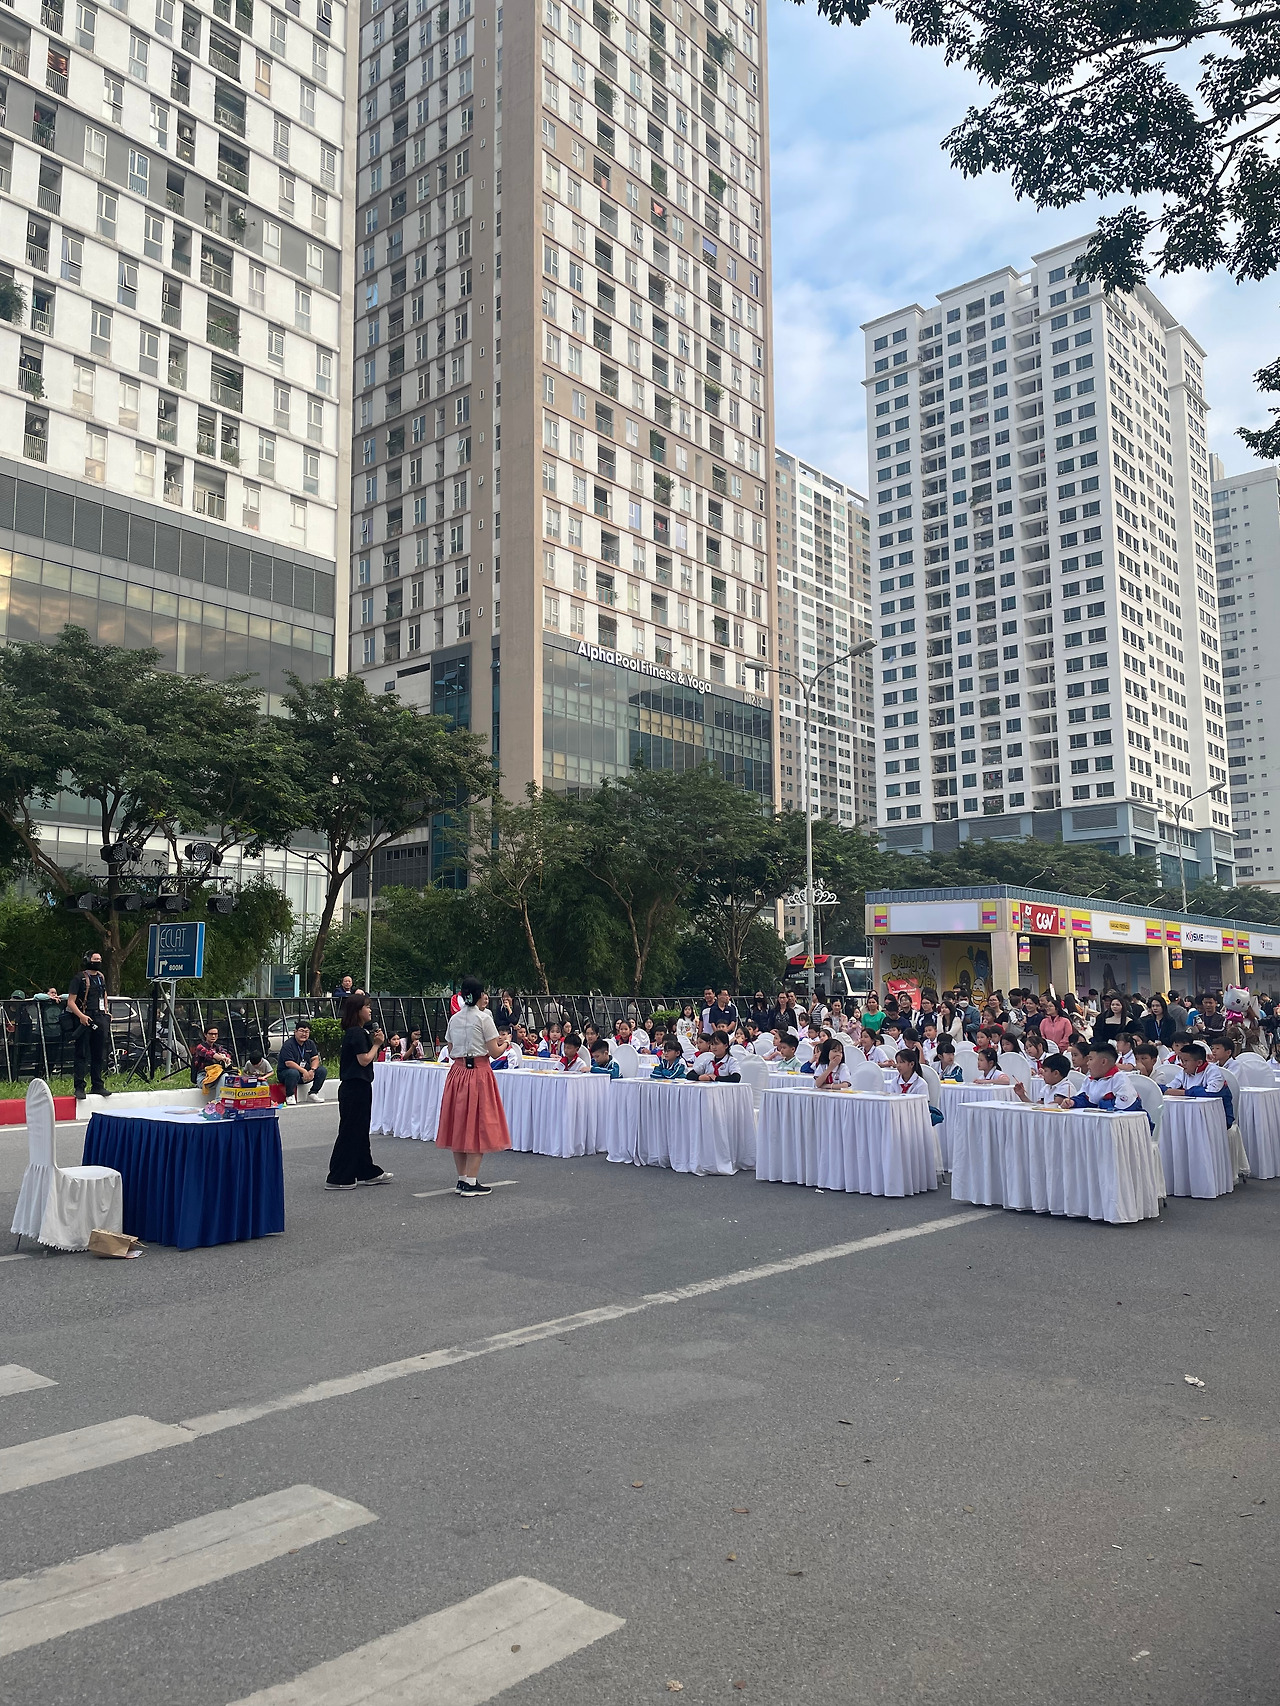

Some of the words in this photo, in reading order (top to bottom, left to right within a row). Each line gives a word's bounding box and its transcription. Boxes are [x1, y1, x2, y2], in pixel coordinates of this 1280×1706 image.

[577, 640, 615, 665] Alpha
[615, 651, 640, 672] Pool
[640, 660, 676, 683] Fitness
[677, 671, 685, 685] &
[687, 674, 712, 695] Yoga
[1036, 912, 1054, 931] CGV
